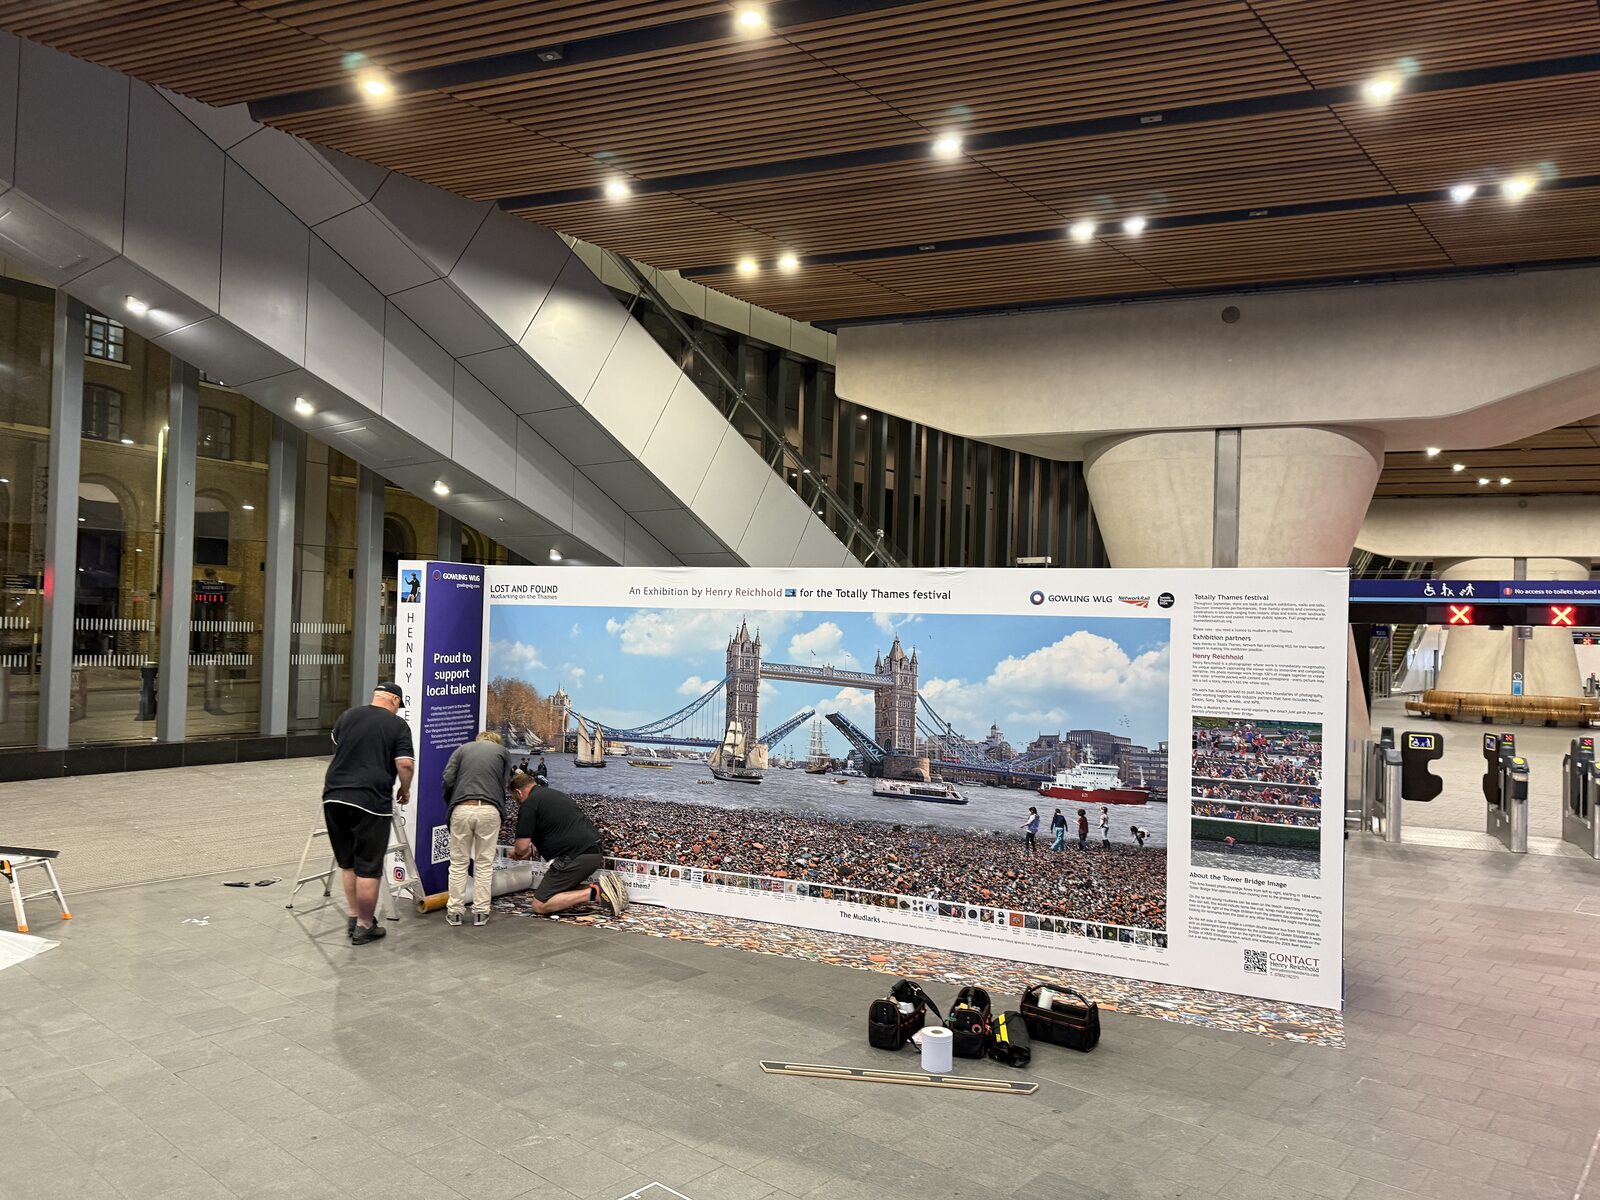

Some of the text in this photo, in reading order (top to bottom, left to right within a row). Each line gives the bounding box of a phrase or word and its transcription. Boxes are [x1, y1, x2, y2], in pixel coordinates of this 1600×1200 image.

[442, 572, 468, 580] GOWLING
[530, 585, 558, 593] FOUND
[644, 587, 689, 596] Exhibition
[692, 587, 702, 598] by
[705, 588, 732, 598] Henry
[735, 588, 782, 597] Reichhold
[800, 589, 814, 597] for
[817, 589, 833, 597] the
[836, 589, 868, 600] Totally
[871, 589, 909, 599] Thames
[913, 590, 951, 599] festival
[1048, 595, 1090, 603] GOWLING
[405, 612, 414, 683] HENRY
[434, 652, 472, 664] Proud to
[435, 669, 470, 682] support
[427, 683, 476, 696] local talent
[1244, 878, 1265, 886] Bridge
[853, 913, 880, 923] Mudlarks
[1270, 952, 1320, 966] CONTACT
[1270, 961, 1288, 969] Henry
[1290, 964, 1319, 973] Reichhold
